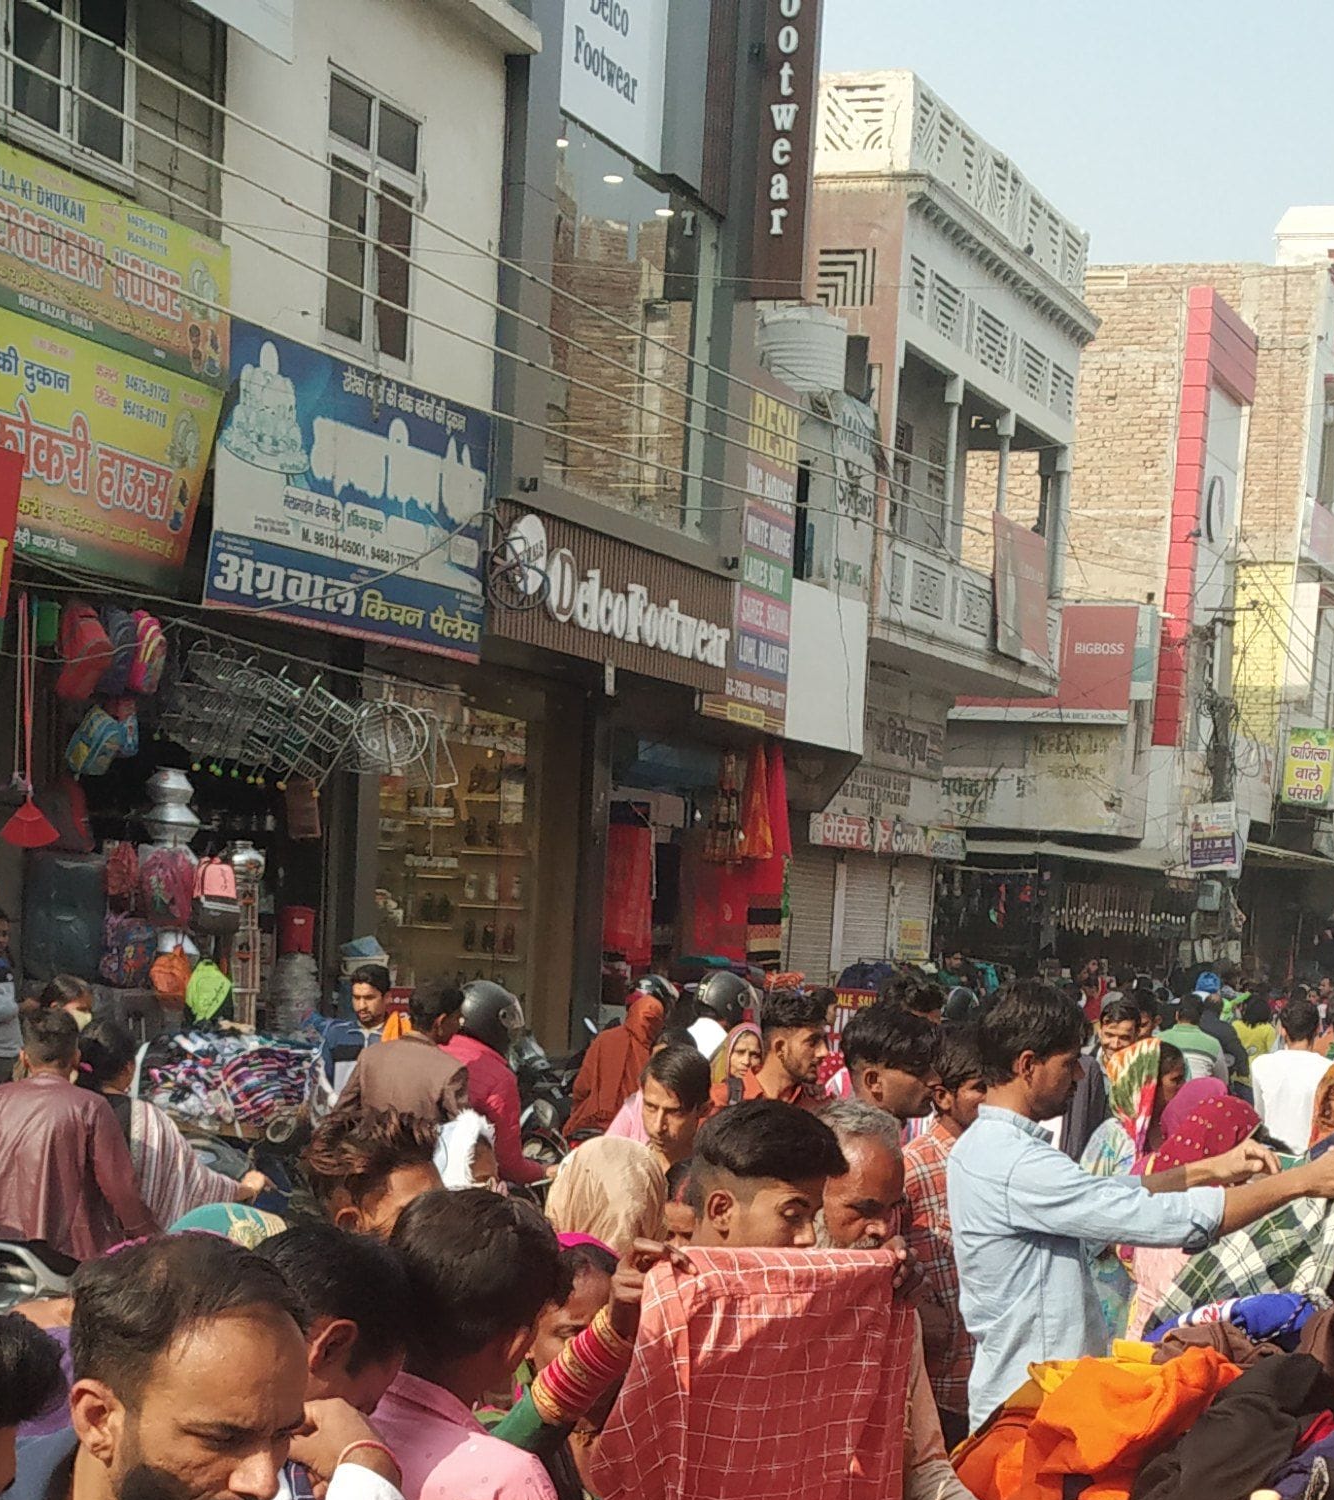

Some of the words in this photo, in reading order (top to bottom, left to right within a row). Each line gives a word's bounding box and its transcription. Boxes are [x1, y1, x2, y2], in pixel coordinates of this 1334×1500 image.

[574, 25, 638, 104] Footwear
[21, 179, 32, 201] KI
[37, 187, 86, 224] DHUKAN
[112, 247, 183, 321] HOUSE
[24, 357, 70, 394] दुकान
[301, 527, 312, 544] M.
[214, 551, 359, 616] अग्रवाल
[360, 588, 426, 629] किचन
[430, 605, 481, 643] पैलेस
[1074, 642, 1125, 654] BIGBOSS
[1295, 765, 1322, 781] वाले
[1288, 784, 1324, 801] पंसारी
